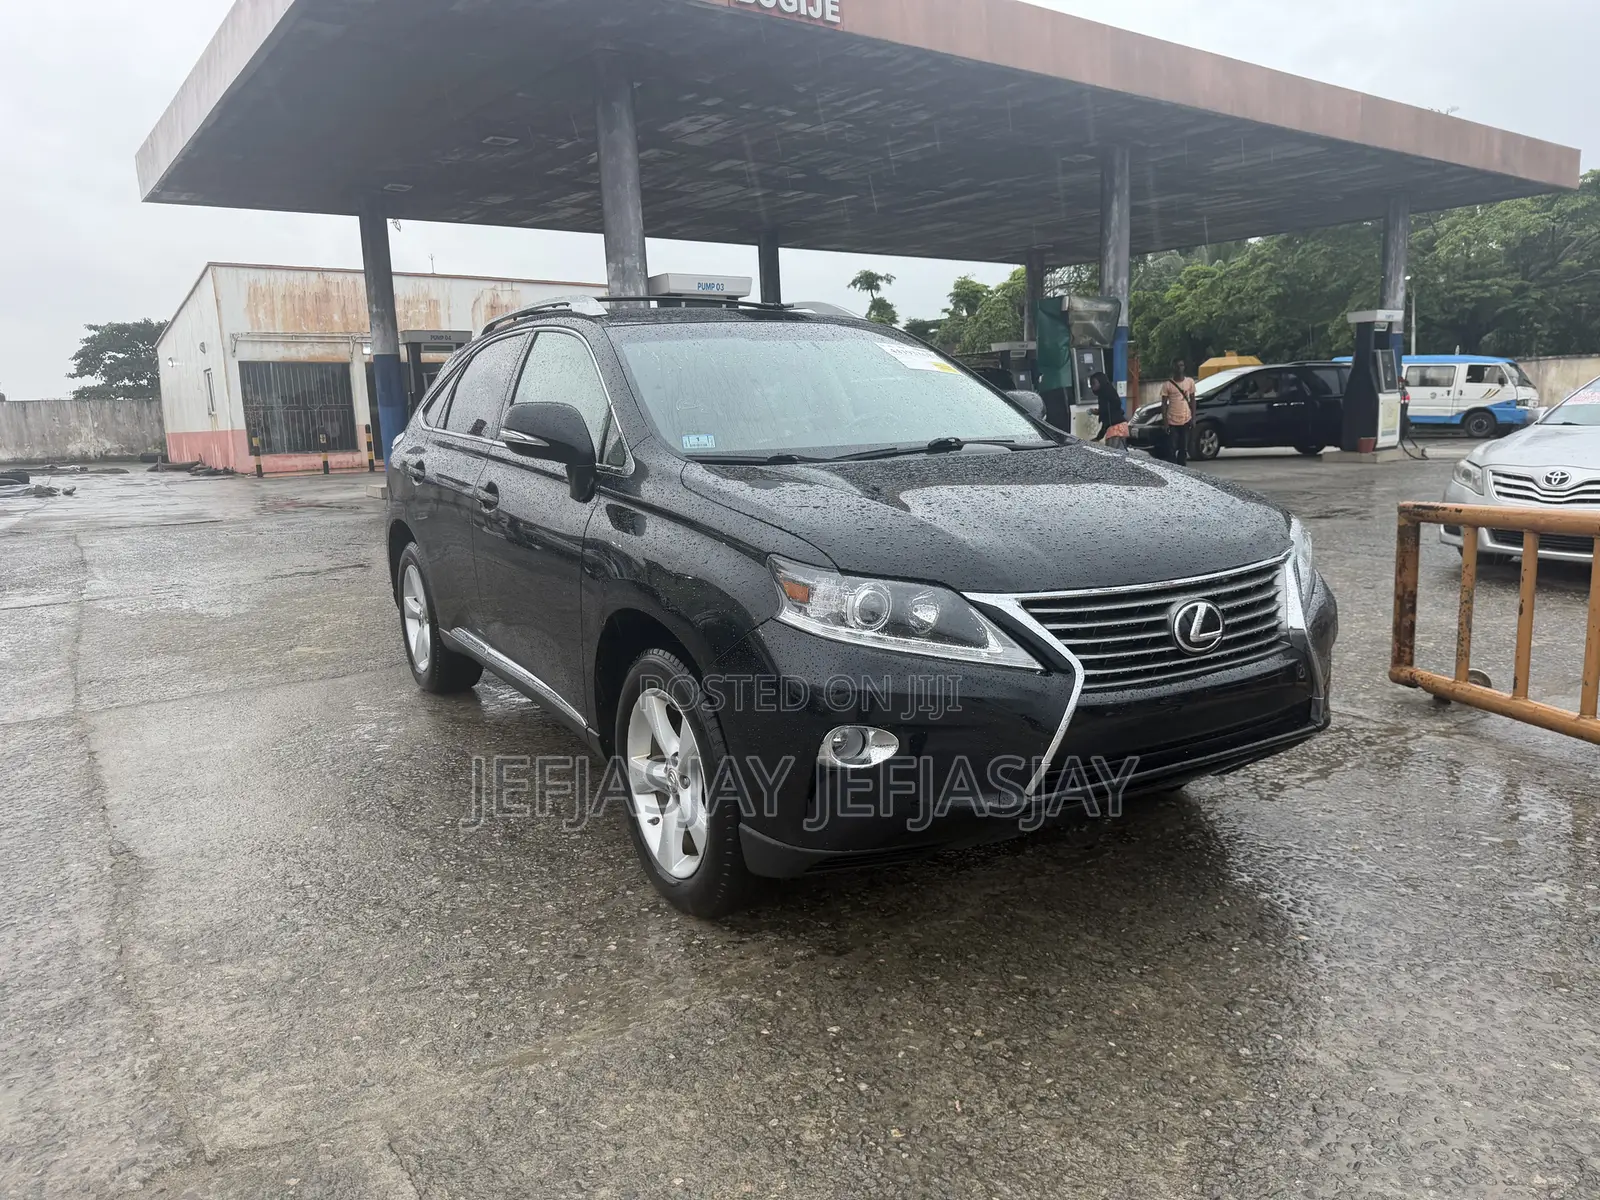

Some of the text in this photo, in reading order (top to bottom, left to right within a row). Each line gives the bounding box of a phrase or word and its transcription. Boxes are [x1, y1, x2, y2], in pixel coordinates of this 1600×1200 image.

[736, 0, 841, 23] GIJE
[697, 282, 725, 291] PUMP 03
